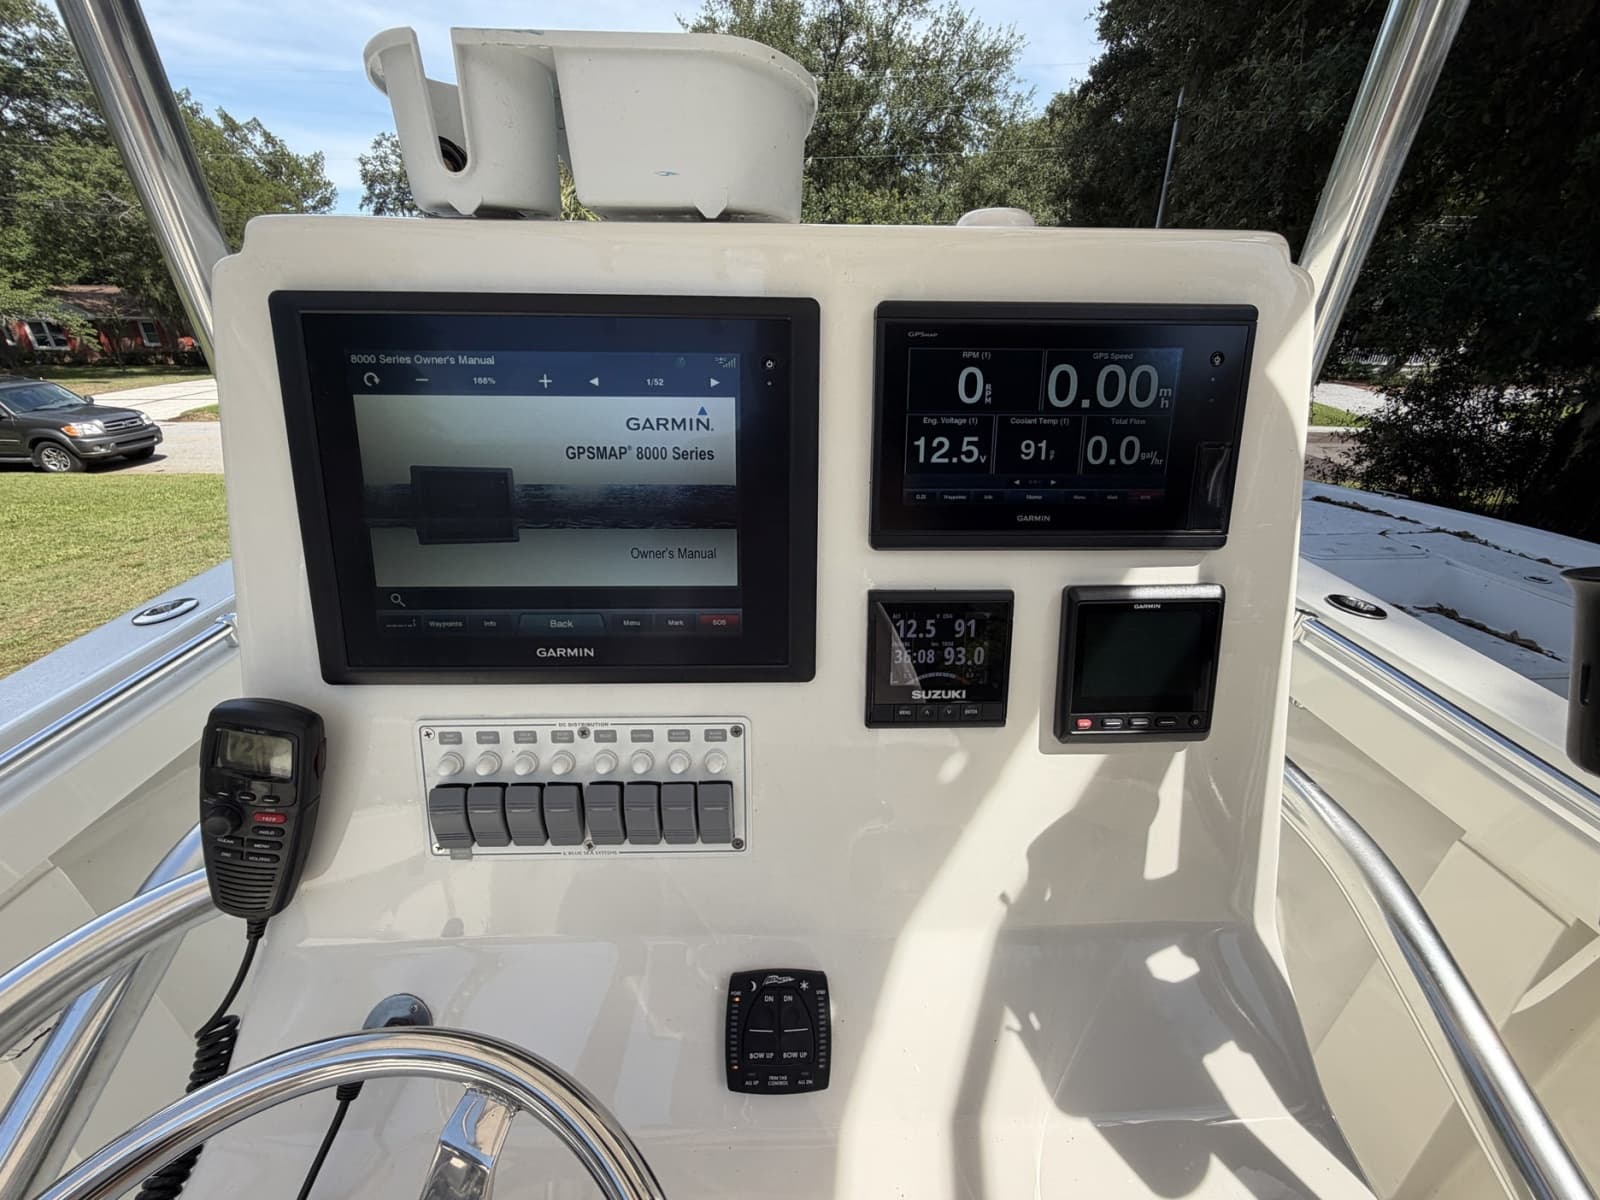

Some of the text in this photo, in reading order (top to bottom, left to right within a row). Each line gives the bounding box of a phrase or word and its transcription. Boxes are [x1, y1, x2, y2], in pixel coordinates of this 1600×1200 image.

[350, 354, 495, 366] 8000 Series Owner's Manual
[962, 351, 979, 359] RPM
[1092, 352, 1134, 361] GPS Speed
[958, 366, 984, 404] 0
[1047, 363, 1159, 409] 0.00
[940, 416, 967, 426] Voltage
[1010, 417, 1037, 425] Coolant
[1038, 417, 1058, 426] Temp
[636, 446, 668, 461] 8000
[672, 446, 715, 461] Series
[913, 435, 980, 464] 12.5
[1020, 439, 1047, 461] 91
[1087, 435, 1140, 465] 0.0
[1016, 514, 1051, 522] GARMIN
[630, 547, 717, 559] Owner's Manual
[549, 618, 574, 628] Back
[896, 619, 936, 638] 12.5
[954, 618, 976, 638] 91
[536, 647, 595, 657] GARMIN
[943, 646, 985, 666] 93.0
[911, 689, 967, 700] SUZUKI
[764, 994, 775, 1003] DN
[783, 994, 793, 1003] DN
[749, 1052, 765, 1060] BOW
[783, 1051, 808, 1059] BOW UP
